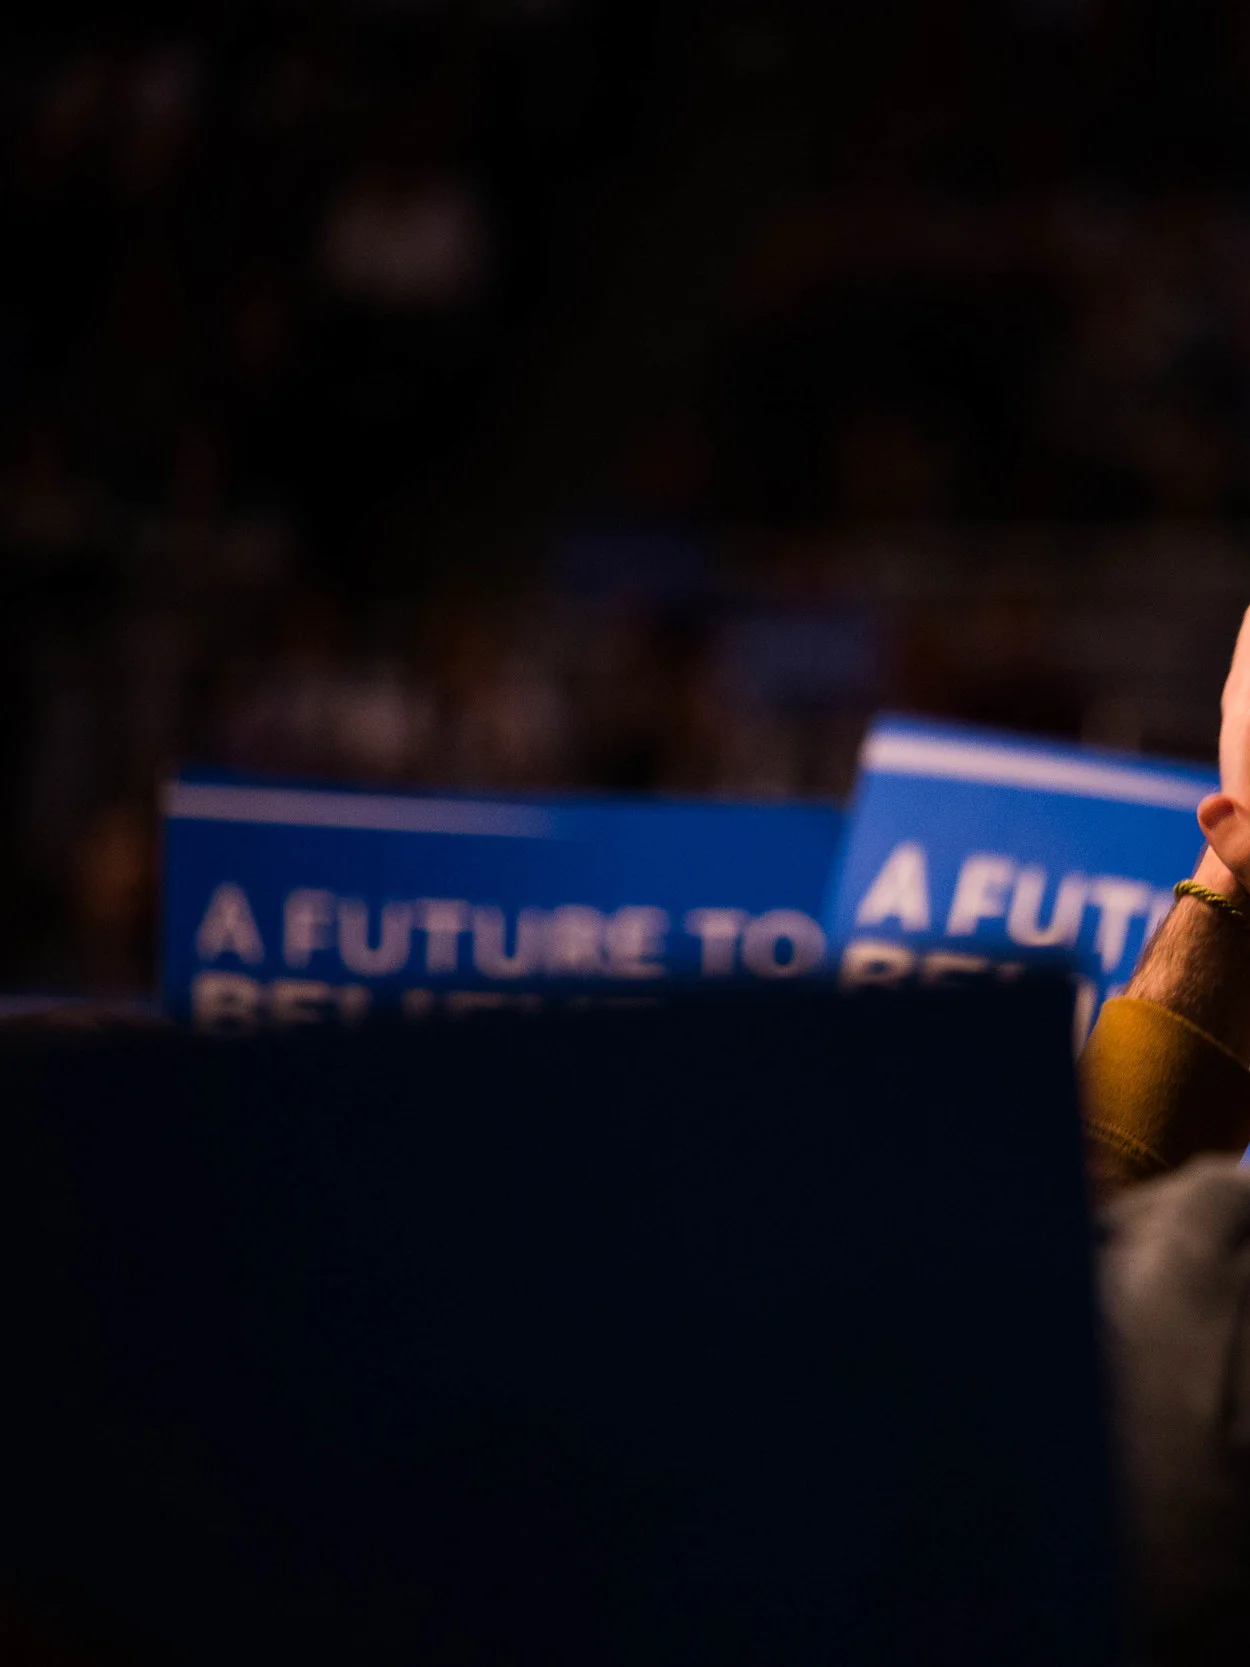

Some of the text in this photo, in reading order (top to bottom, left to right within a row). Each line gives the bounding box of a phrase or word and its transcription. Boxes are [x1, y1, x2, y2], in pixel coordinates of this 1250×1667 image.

[195, 882, 264, 966] A
[282, 888, 669, 980] FUTURE
[686, 906, 828, 980] TO
[856, 840, 932, 934] A
[945, 852, 1178, 976] FUT
